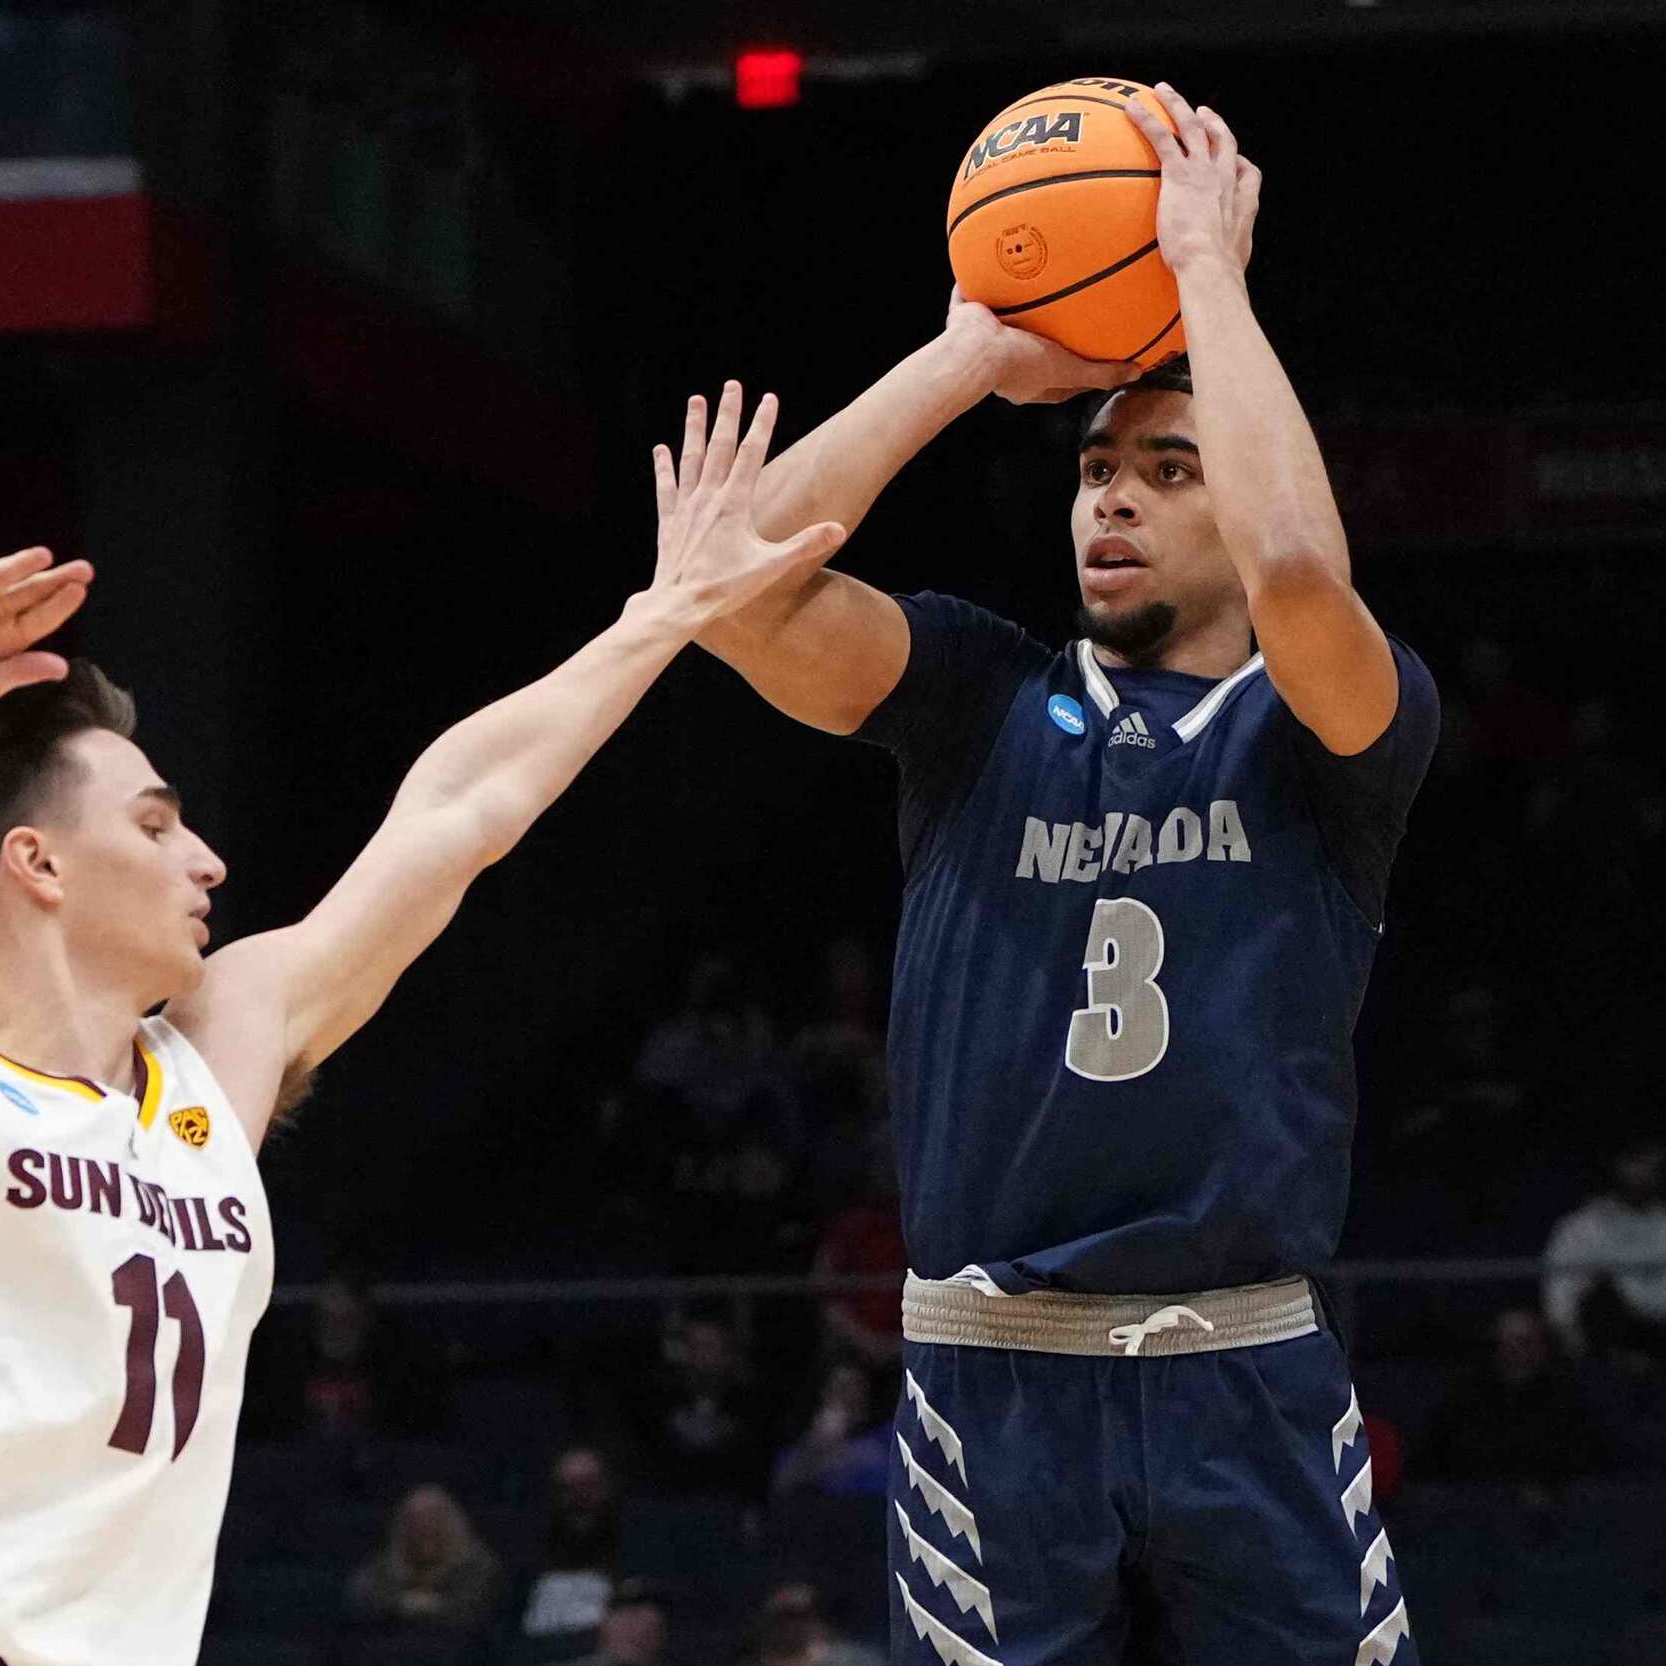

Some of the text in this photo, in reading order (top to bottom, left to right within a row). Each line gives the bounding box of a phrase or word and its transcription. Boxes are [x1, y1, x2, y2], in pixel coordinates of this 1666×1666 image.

[961, 111, 1084, 182] NCAA
[1039, 146, 1077, 154] BALL
[1107, 732, 1156, 750] adidas
[1064, 896, 1171, 1082] 3
[5, 1148, 253, 1254] SUN DEILS
[106, 1252, 206, 1464] 11
